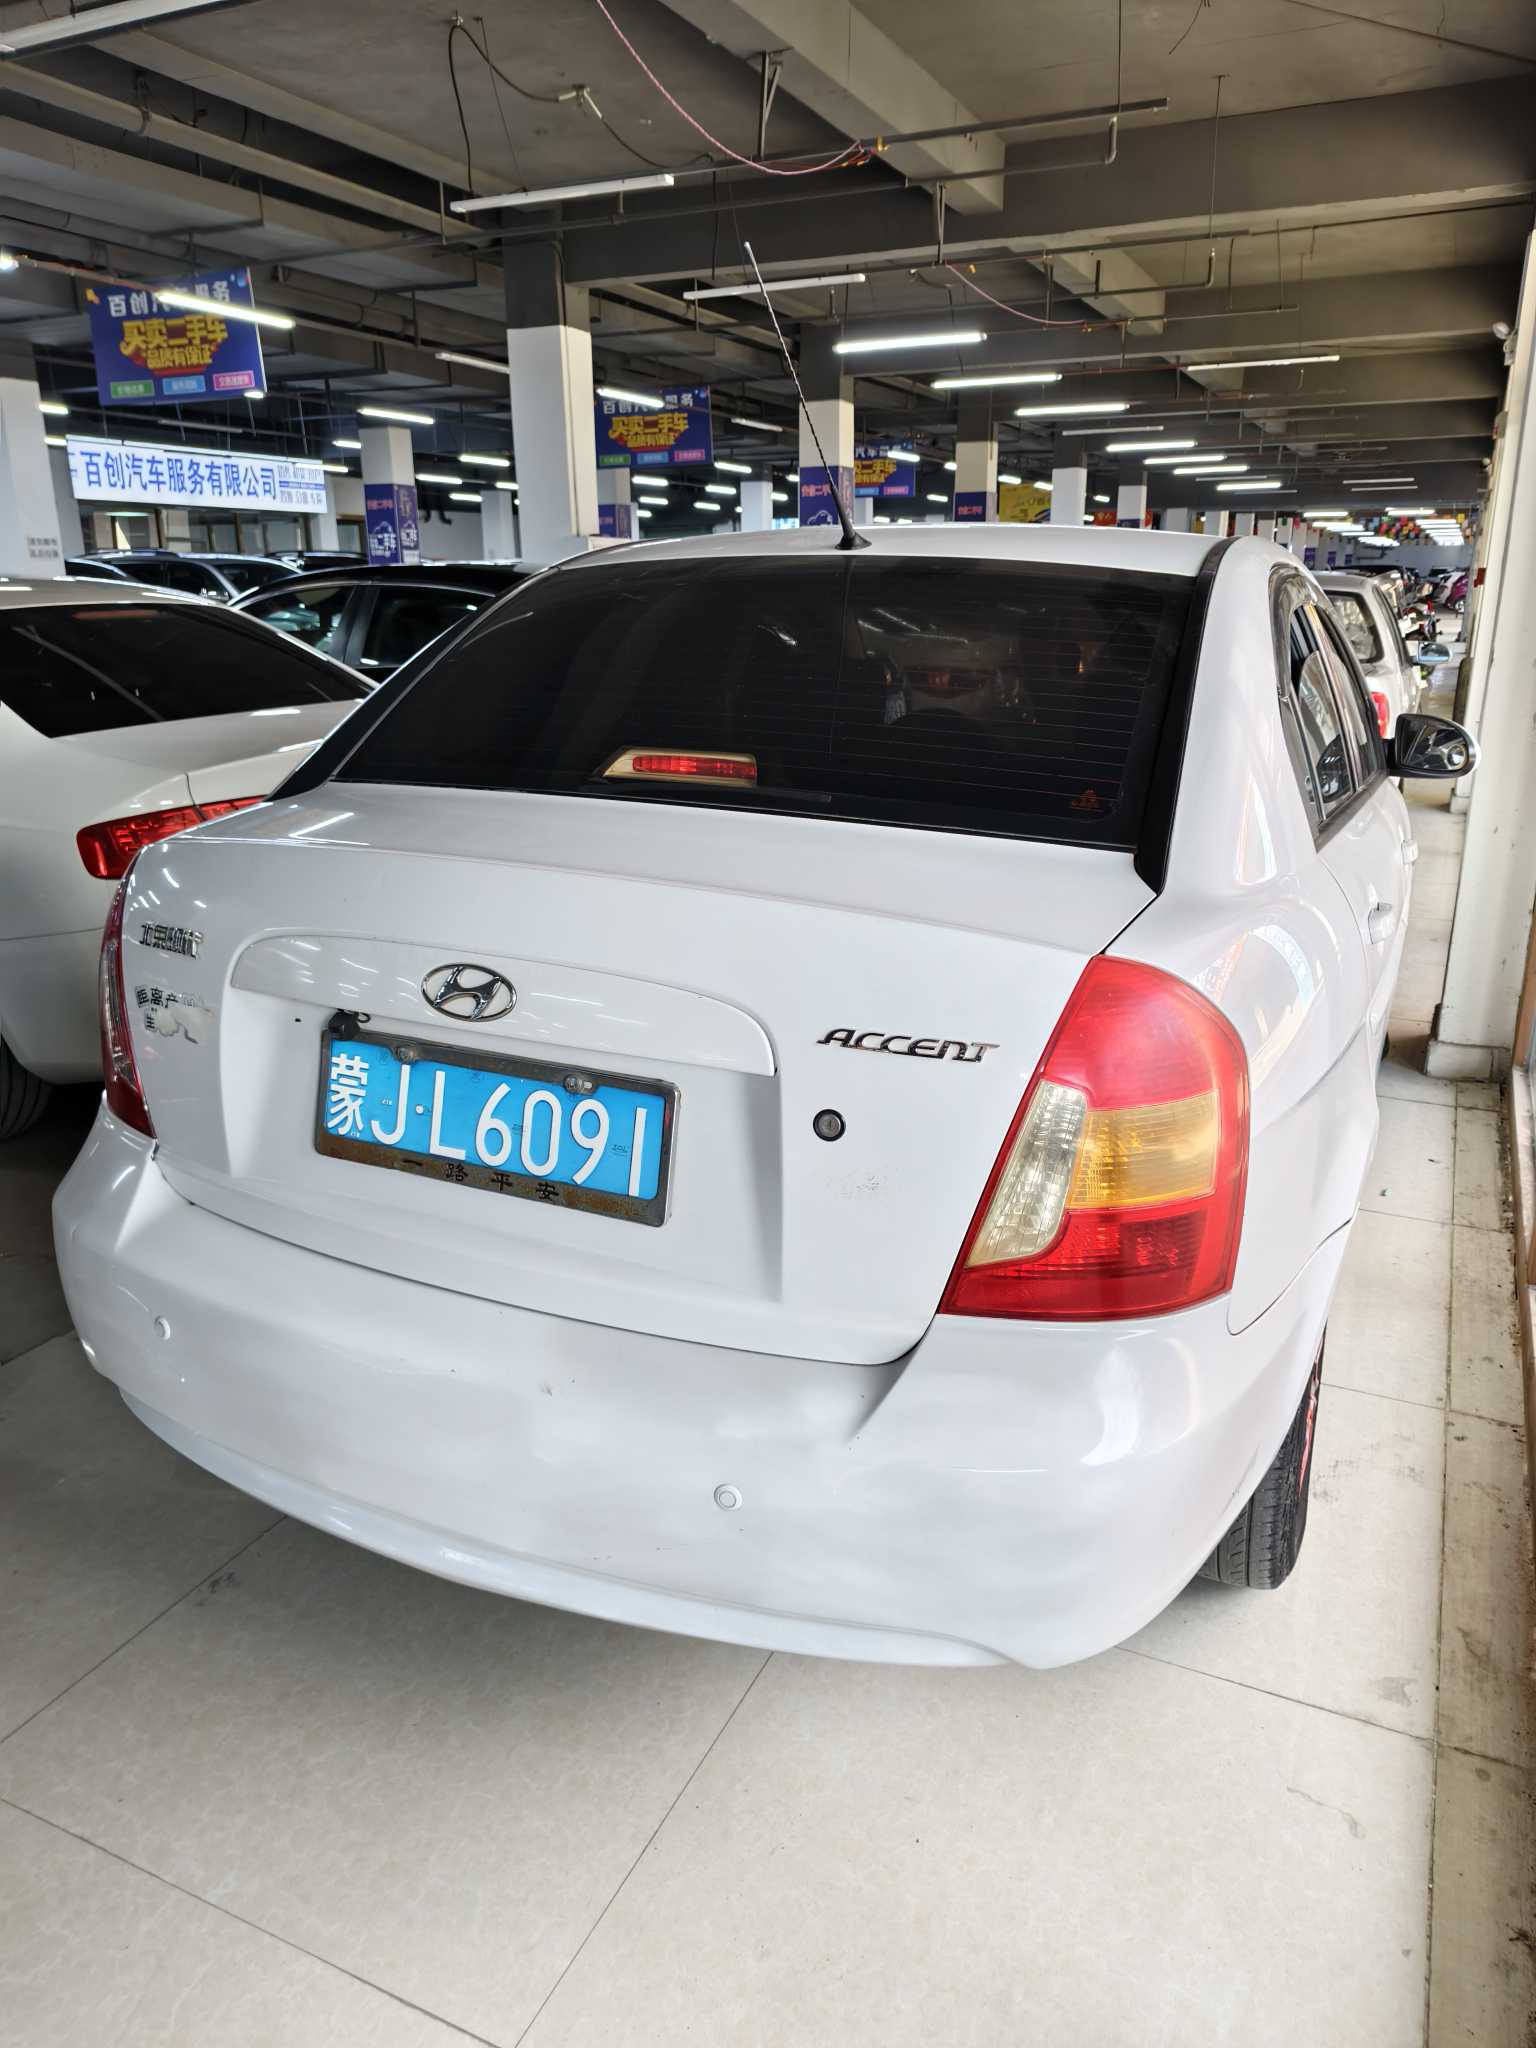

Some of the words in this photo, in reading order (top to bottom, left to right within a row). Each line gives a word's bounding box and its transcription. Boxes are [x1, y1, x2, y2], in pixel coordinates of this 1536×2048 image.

[108, 281, 231, 317] 百创服务
[120, 313, 229, 356] 买卖二手车
[68, 450, 276, 500] 百创汽车服务有限公司
[816, 1028, 1000, 1062] ACCENT
[403, 1159, 560, 1201] 一路平安
